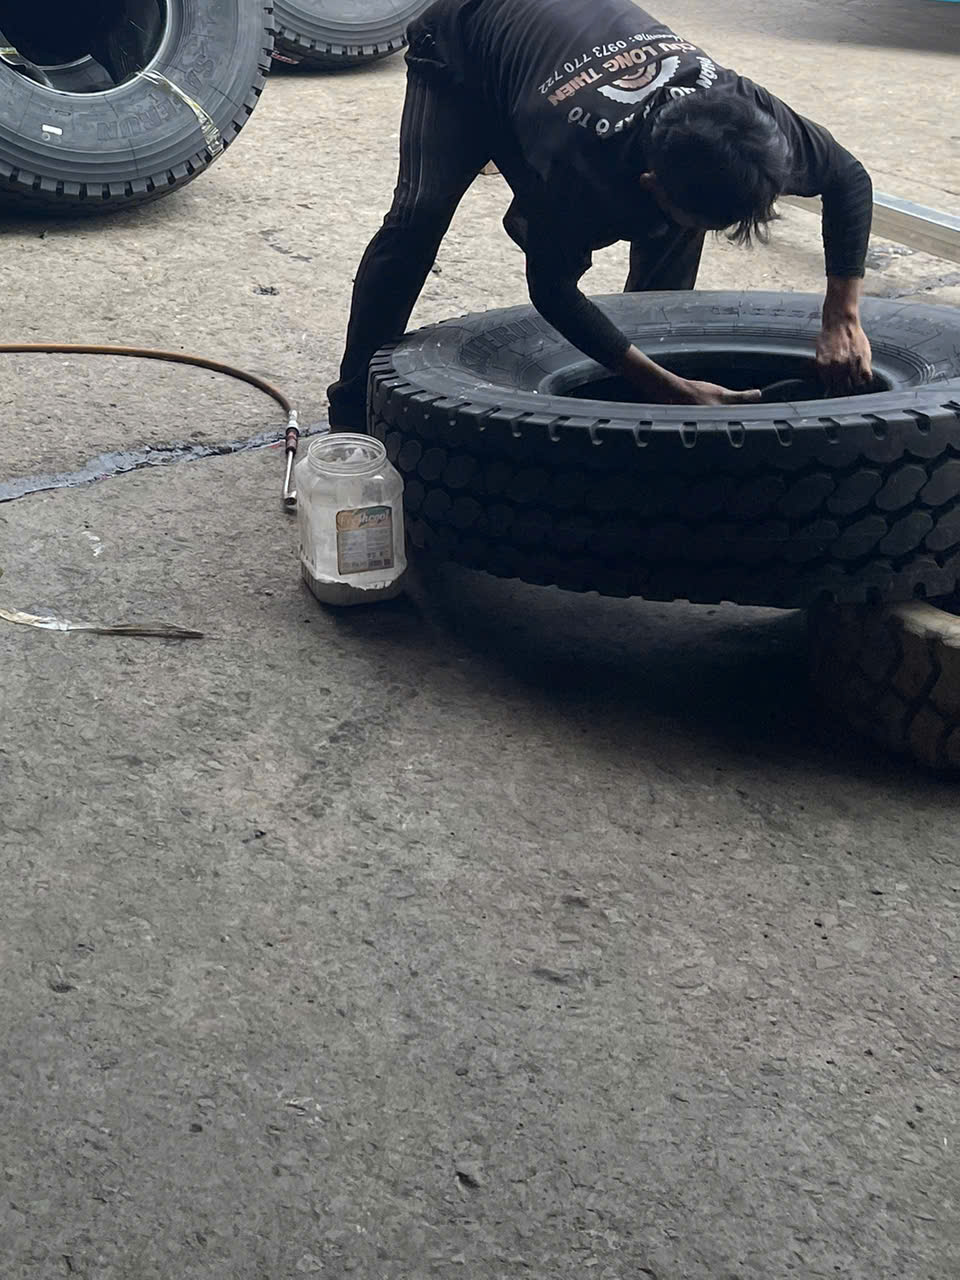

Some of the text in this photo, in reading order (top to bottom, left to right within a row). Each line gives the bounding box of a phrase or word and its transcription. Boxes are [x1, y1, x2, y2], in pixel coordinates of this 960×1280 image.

[591, 40, 628, 58] 0973
[602, 47, 658, 72] LONG
[563, 53, 592, 73] 770
[538, 72, 564, 94] 722
[547, 67, 603, 107] THIÊN
[567, 106, 592, 129] TÔ
